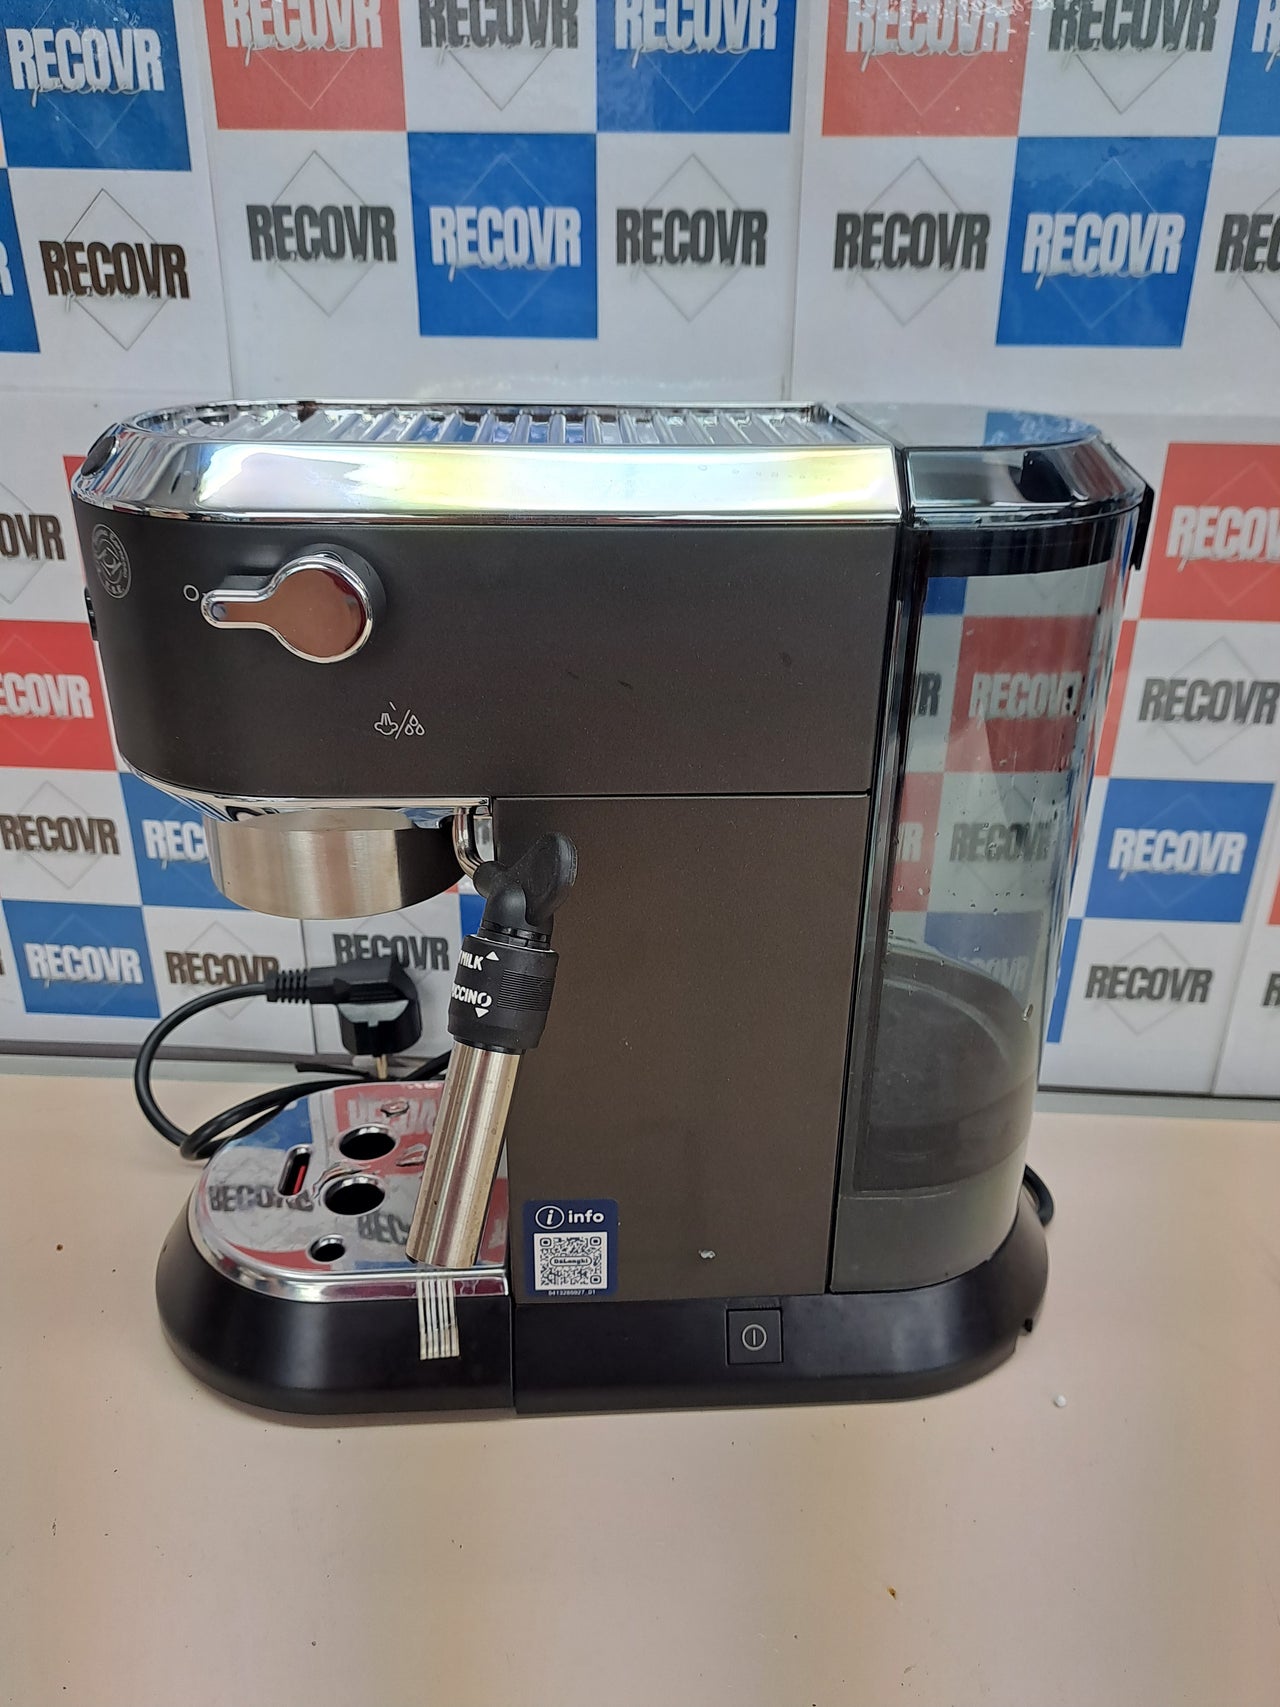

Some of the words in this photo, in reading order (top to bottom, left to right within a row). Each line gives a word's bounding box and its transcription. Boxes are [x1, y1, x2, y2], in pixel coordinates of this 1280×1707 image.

[222, 0, 383, 48] RECOVR
[419, 0, 578, 48] RECOVR
[615, 0, 778, 50] RECOVR
[846, 0, 1013, 52] RECOVR
[1048, 0, 1220, 52] RECOVR
[6, 28, 165, 91] RECOVR
[246, 204, 397, 262] RECOVR
[429, 206, 581, 267] RECOVR
[616, 208, 767, 265] RECOVR
[833, 212, 991, 270] RECOVR
[1021, 212, 1186, 274] RECOVR
[39, 240, 190, 299] RECOVR
[1138, 678, 1280, 725] RECOVR
[0, 815, 120, 855] RECOVR
[1108, 828, 1248, 876] RECOVR
[24, 942, 144, 985] RECOVR
[333, 934, 450, 971] RECOVR
[1086, 965, 1213, 1003] RECOVR
[568, 1209, 604, 1223] info
